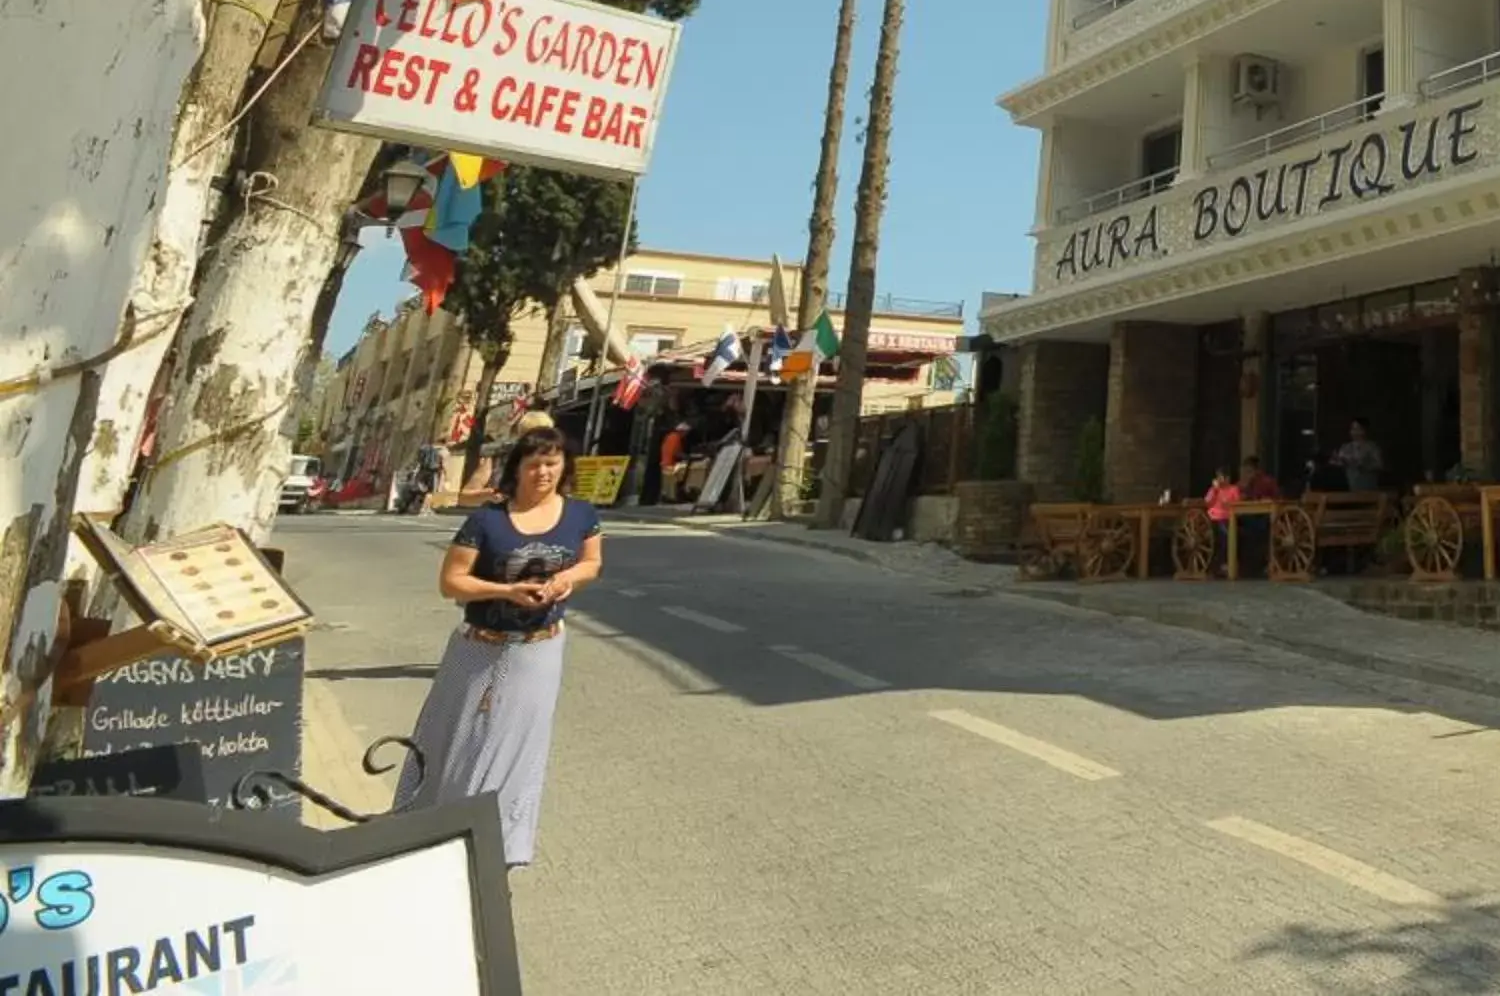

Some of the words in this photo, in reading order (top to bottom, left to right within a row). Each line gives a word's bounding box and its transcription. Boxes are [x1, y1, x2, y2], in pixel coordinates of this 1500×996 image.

[347, 44, 451, 105] REST
[453, 68, 481, 113] &
[490, 76, 581, 134] CAFE
[581, 95, 648, 149] BAR
[526, 15, 665, 91] GARDEN
[1194, 99, 1483, 241] BOUTIQUE
[91, 706, 170, 731] Grillade
